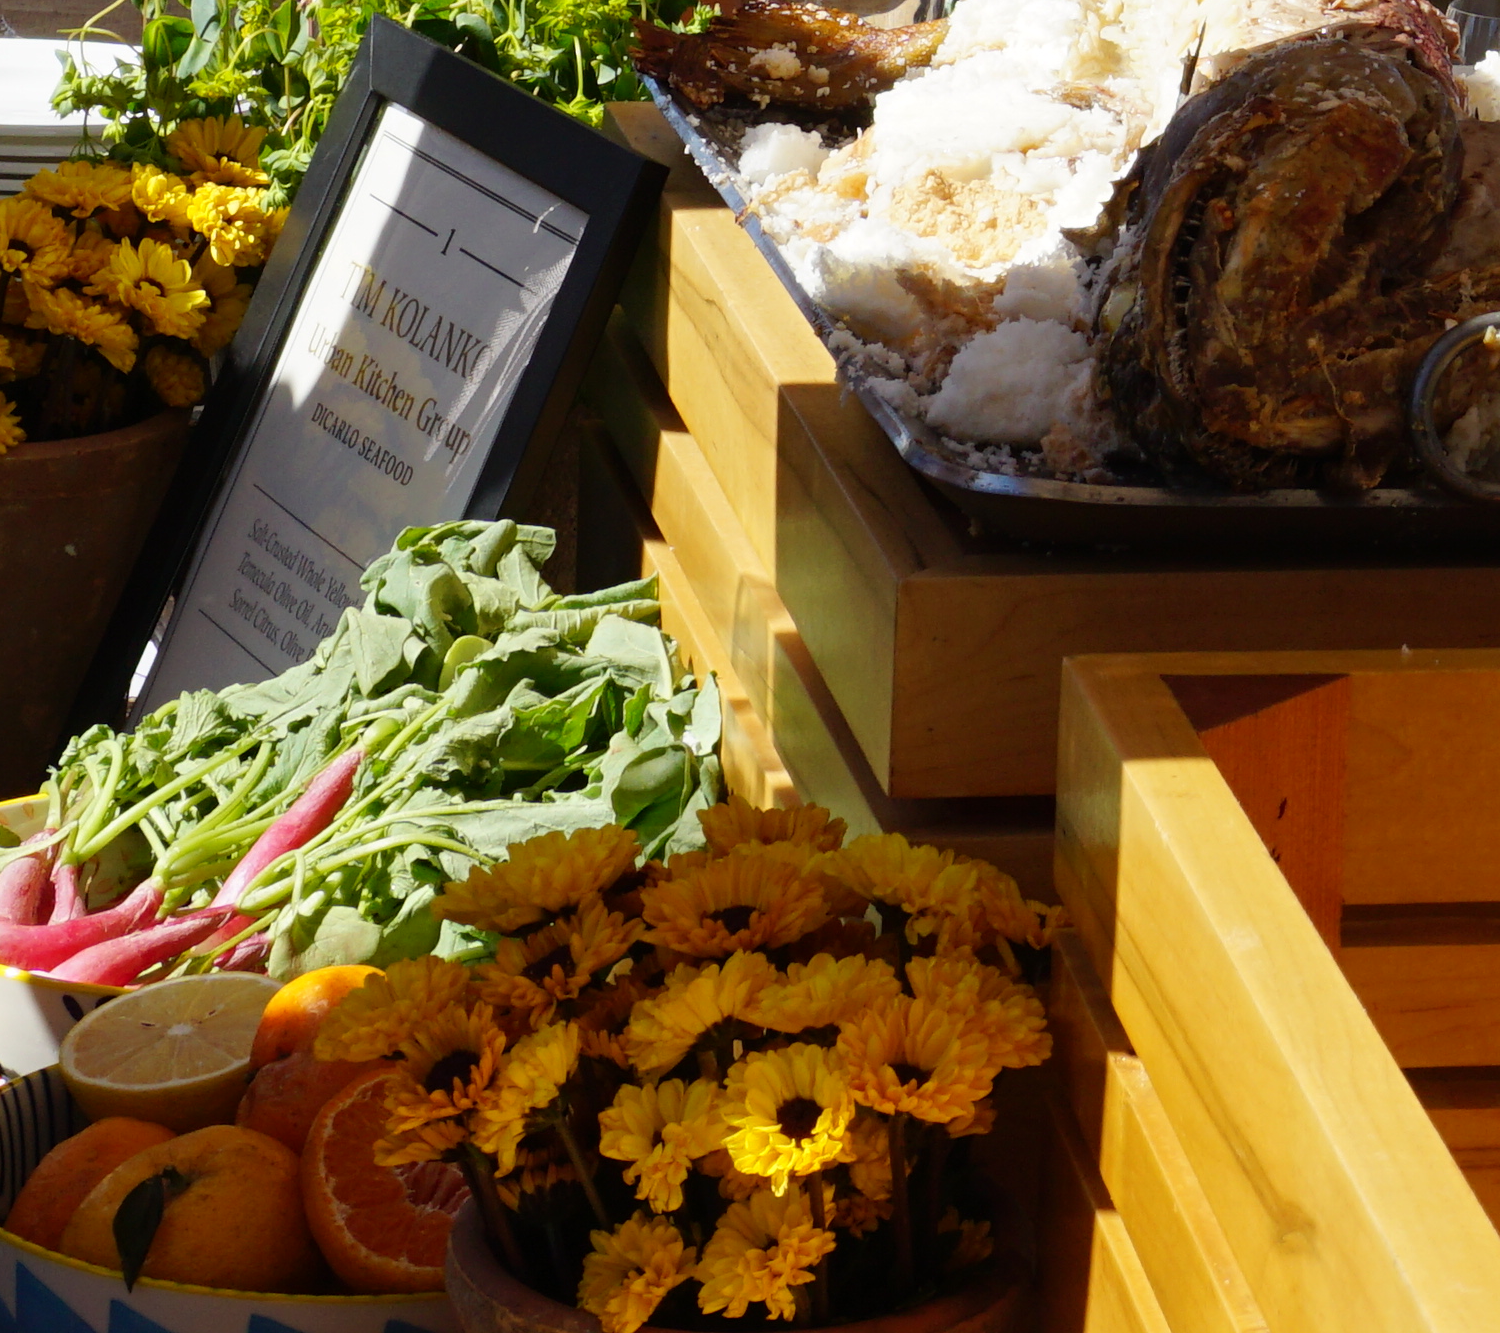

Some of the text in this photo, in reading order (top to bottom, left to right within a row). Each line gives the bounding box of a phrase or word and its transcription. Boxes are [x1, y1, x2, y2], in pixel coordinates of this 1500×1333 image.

[440, 229, 456, 256] 1
[341, 260, 387, 319] TIM
[308, 323, 473, 465] Urban Kitchen Group
[311, 402, 414, 487] DICARLO SEAFOOD
[237, 551, 276, 597] Temecula
[273, 581, 298, 614] Olive
[295, 599, 315, 629] Oil,
[248, 518, 300, 570] Salt-Crusted
[296, 555, 326, 593] Whole
[228, 588, 257, 622] Sorrel
[252, 607, 281, 645] Citrus,
[280, 630, 304, 663] Olive
